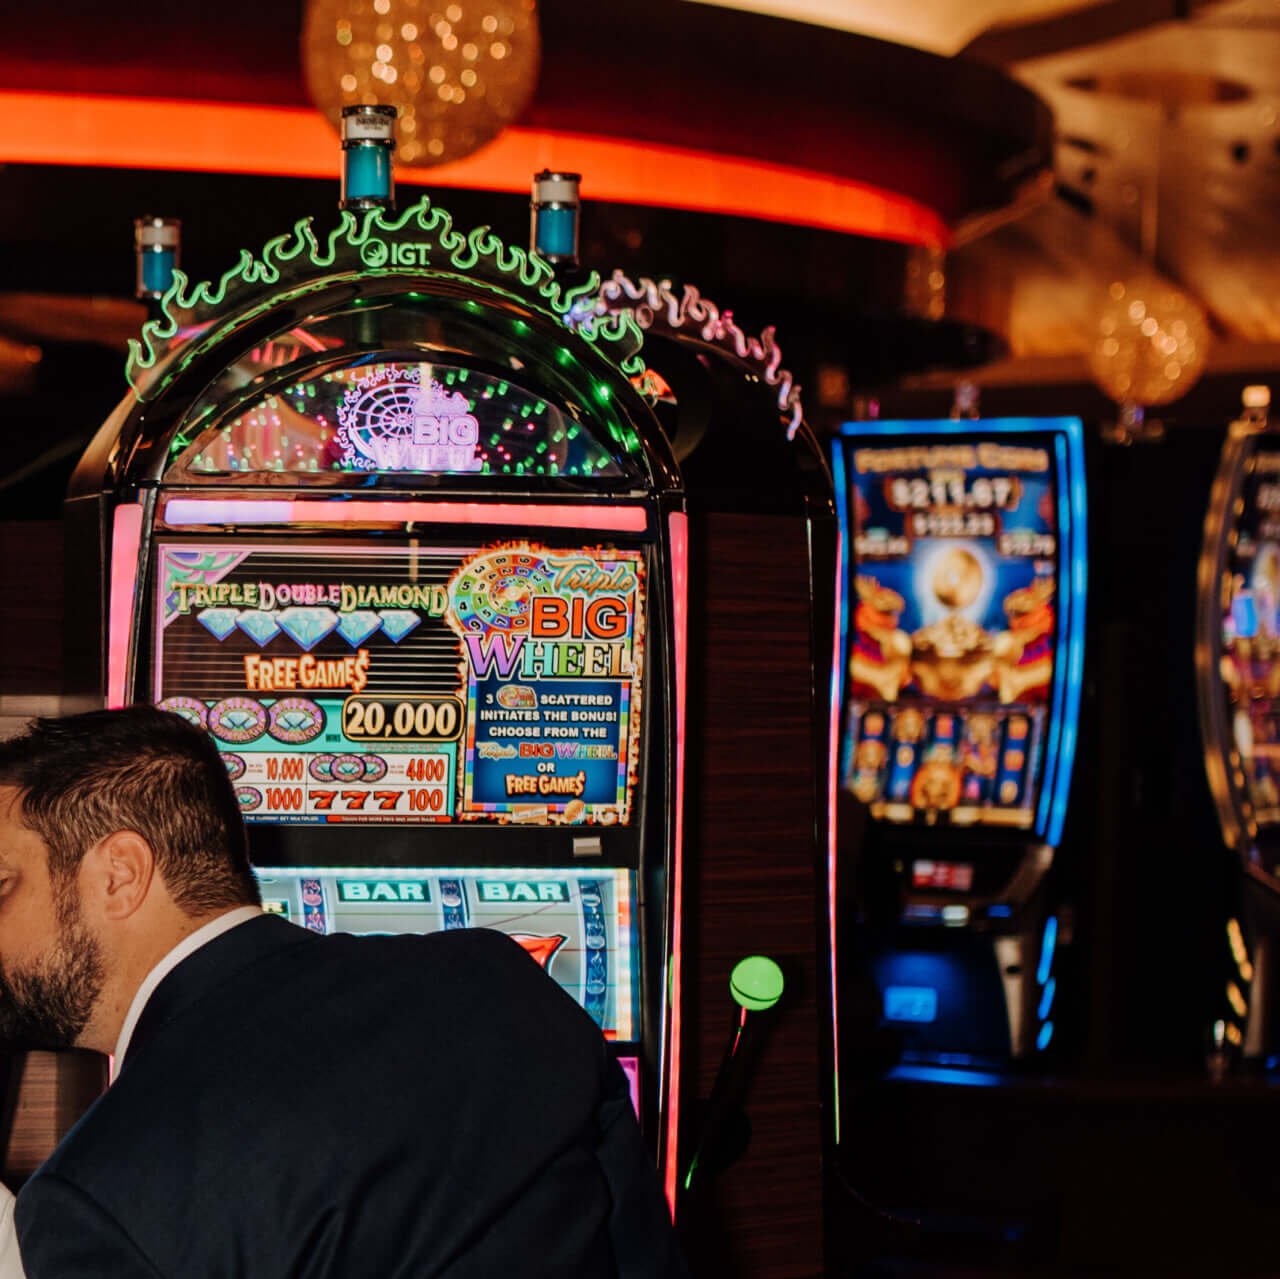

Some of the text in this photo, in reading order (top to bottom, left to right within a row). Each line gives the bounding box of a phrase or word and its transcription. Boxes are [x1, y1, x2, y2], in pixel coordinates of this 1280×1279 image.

[391, 242, 432, 265] IGT
[413, 415, 479, 446] BIG
[548, 558, 636, 596] Triple
[171, 582, 449, 617] TRIPLE DOUBLE DIAMOND
[531, 597, 628, 640] BIG
[464, 633, 634, 680] WHEEL
[245, 655, 297, 689] FREE
[486, 694, 613, 706] 3 SCATTERED
[346, 701, 457, 738] 20,000
[480, 711, 617, 722] INITIATES THE BONUS!
[489, 727, 607, 738] CHOOSE FROM THE
[519, 743, 554, 758] BIG
[555, 742, 618, 759] WHEEL
[266, 758, 304, 780] 10,000
[406, 758, 445, 781] 4800
[537, 763, 555, 773] OR
[505, 774, 538, 795] FREE
[266, 788, 303, 810] 1000
[309, 789, 444, 811] 7 7 7 100
[343, 882, 425, 900] BAR
[483, 882, 564, 900] BAR
